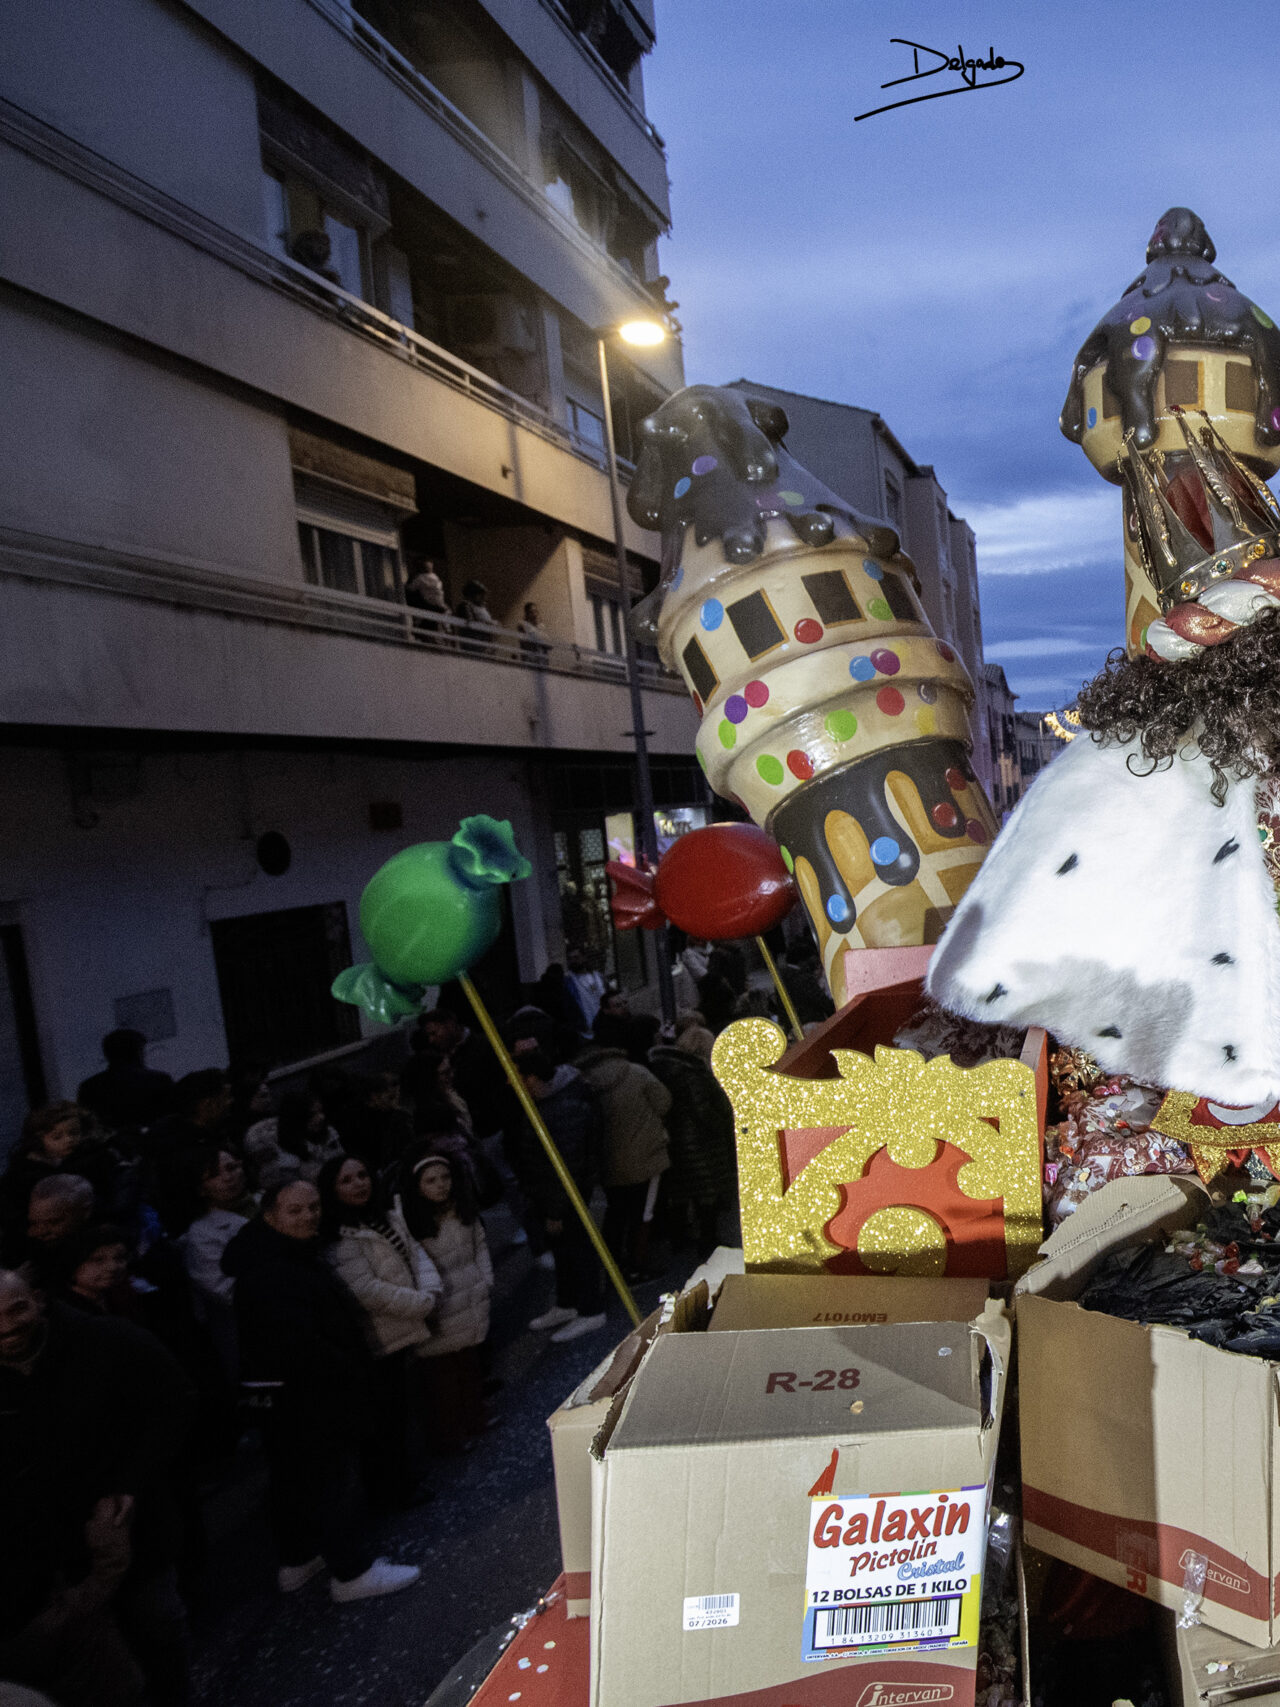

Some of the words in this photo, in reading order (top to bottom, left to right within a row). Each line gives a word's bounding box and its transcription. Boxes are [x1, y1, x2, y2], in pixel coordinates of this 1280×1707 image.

[812, 1312, 888, 1323] EM01017
[765, 1368, 861, 1394] R-28
[813, 1494, 971, 1548] Galaxin
[897, 1551, 966, 1581] Cristal
[812, 1590, 830, 1603] 12
[833, 1585, 892, 1601] BOLSAS
[895, 1583, 916, 1596] DE
[920, 1583, 927, 1594] 1
[931, 1578, 968, 1593] KILO
